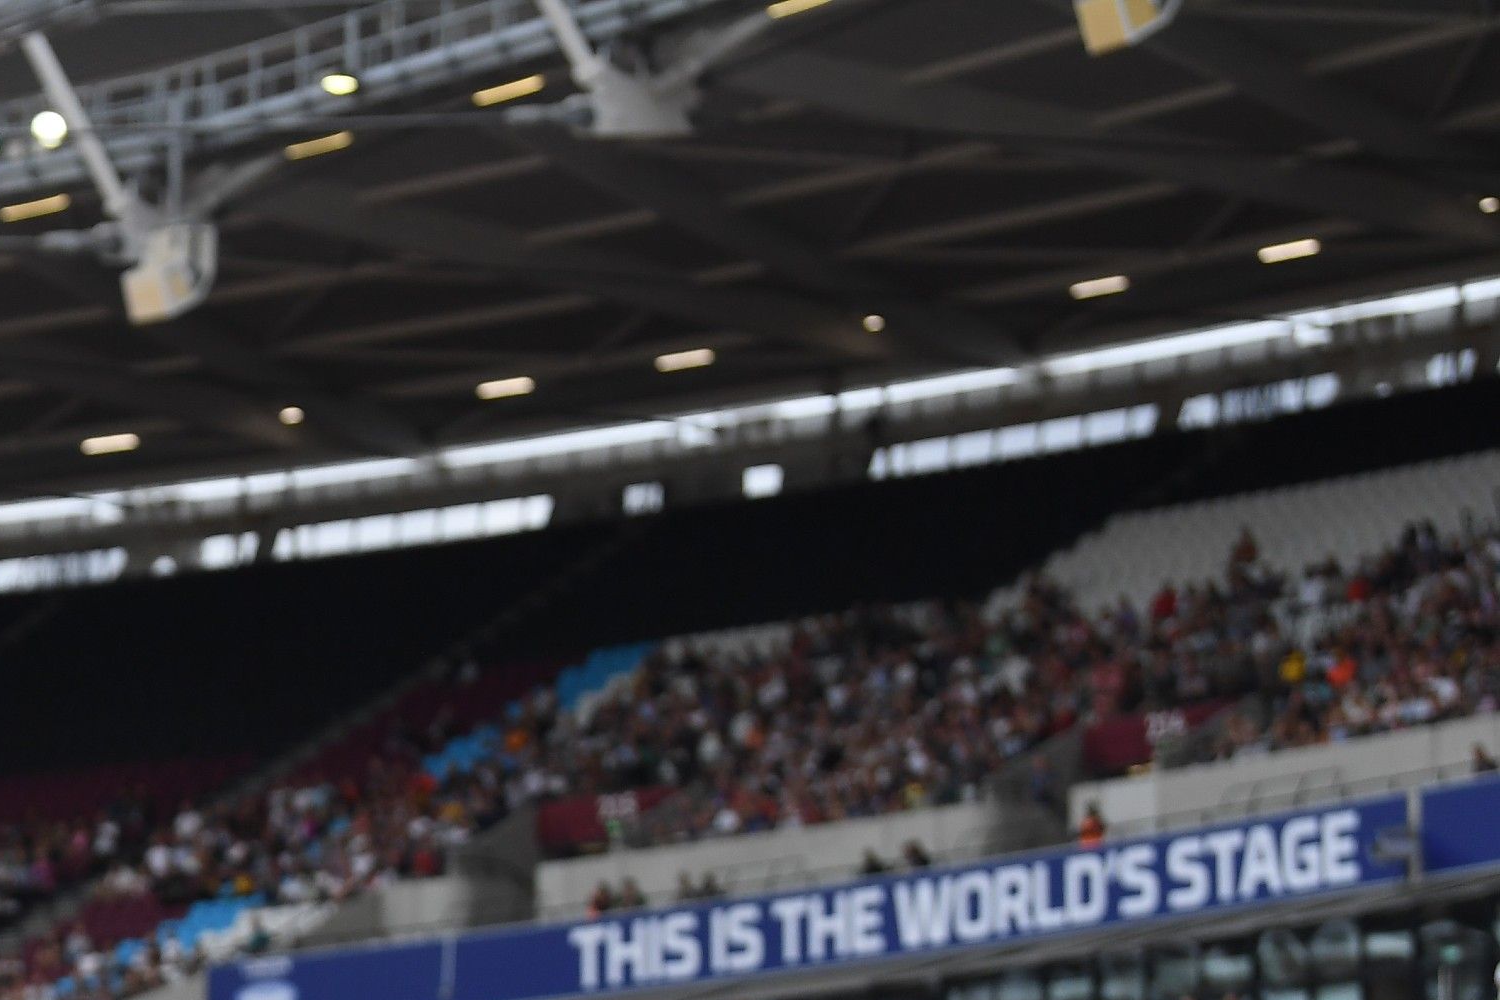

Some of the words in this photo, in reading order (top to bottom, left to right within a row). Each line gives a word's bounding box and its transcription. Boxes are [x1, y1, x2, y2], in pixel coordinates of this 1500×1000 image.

[569, 911, 701, 992] THIS
[709, 903, 766, 974] IS
[770, 886, 888, 965] THE
[894, 846, 1160, 947] WORLD'S
[1167, 809, 1362, 911] STAGE
